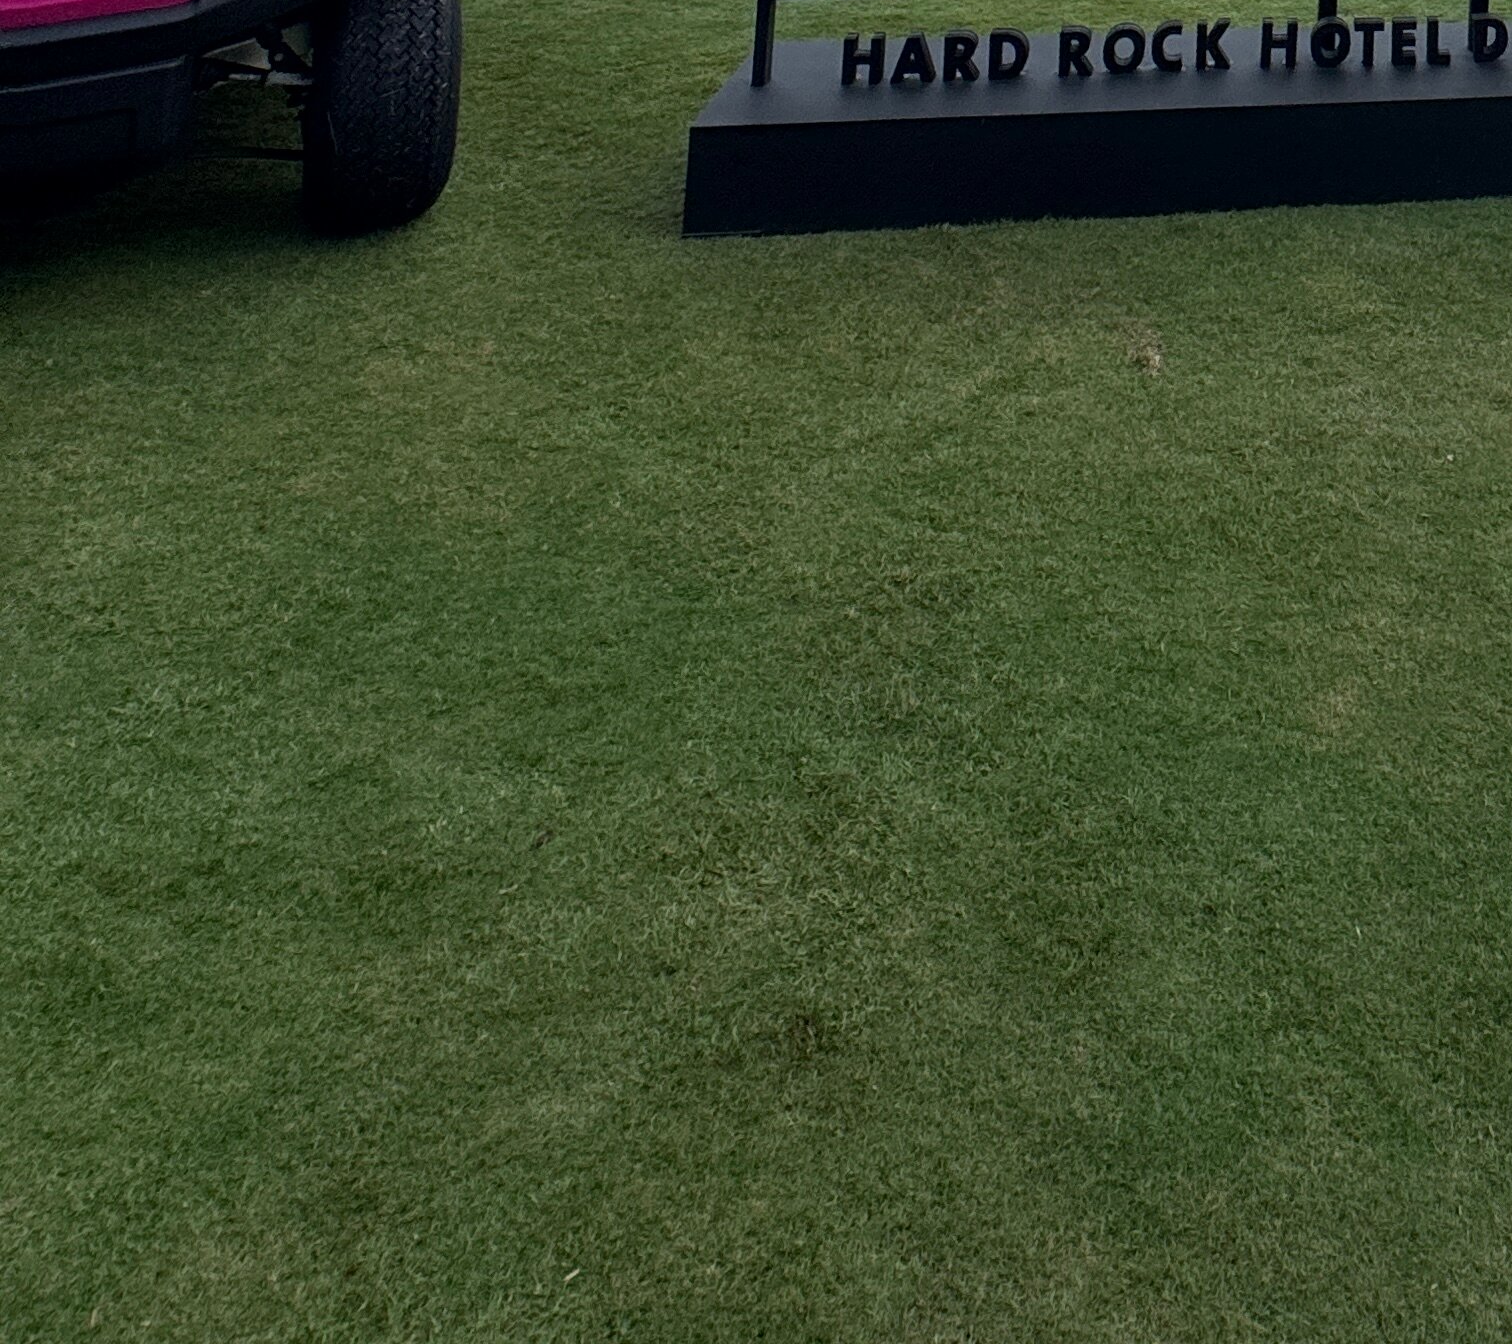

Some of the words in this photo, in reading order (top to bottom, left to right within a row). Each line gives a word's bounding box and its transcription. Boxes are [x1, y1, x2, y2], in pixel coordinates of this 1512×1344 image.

[841, 30, 1030, 85] HARD
[1058, 17, 1231, 77] ROCK
[1260, 15, 1451, 69] HOTEL
